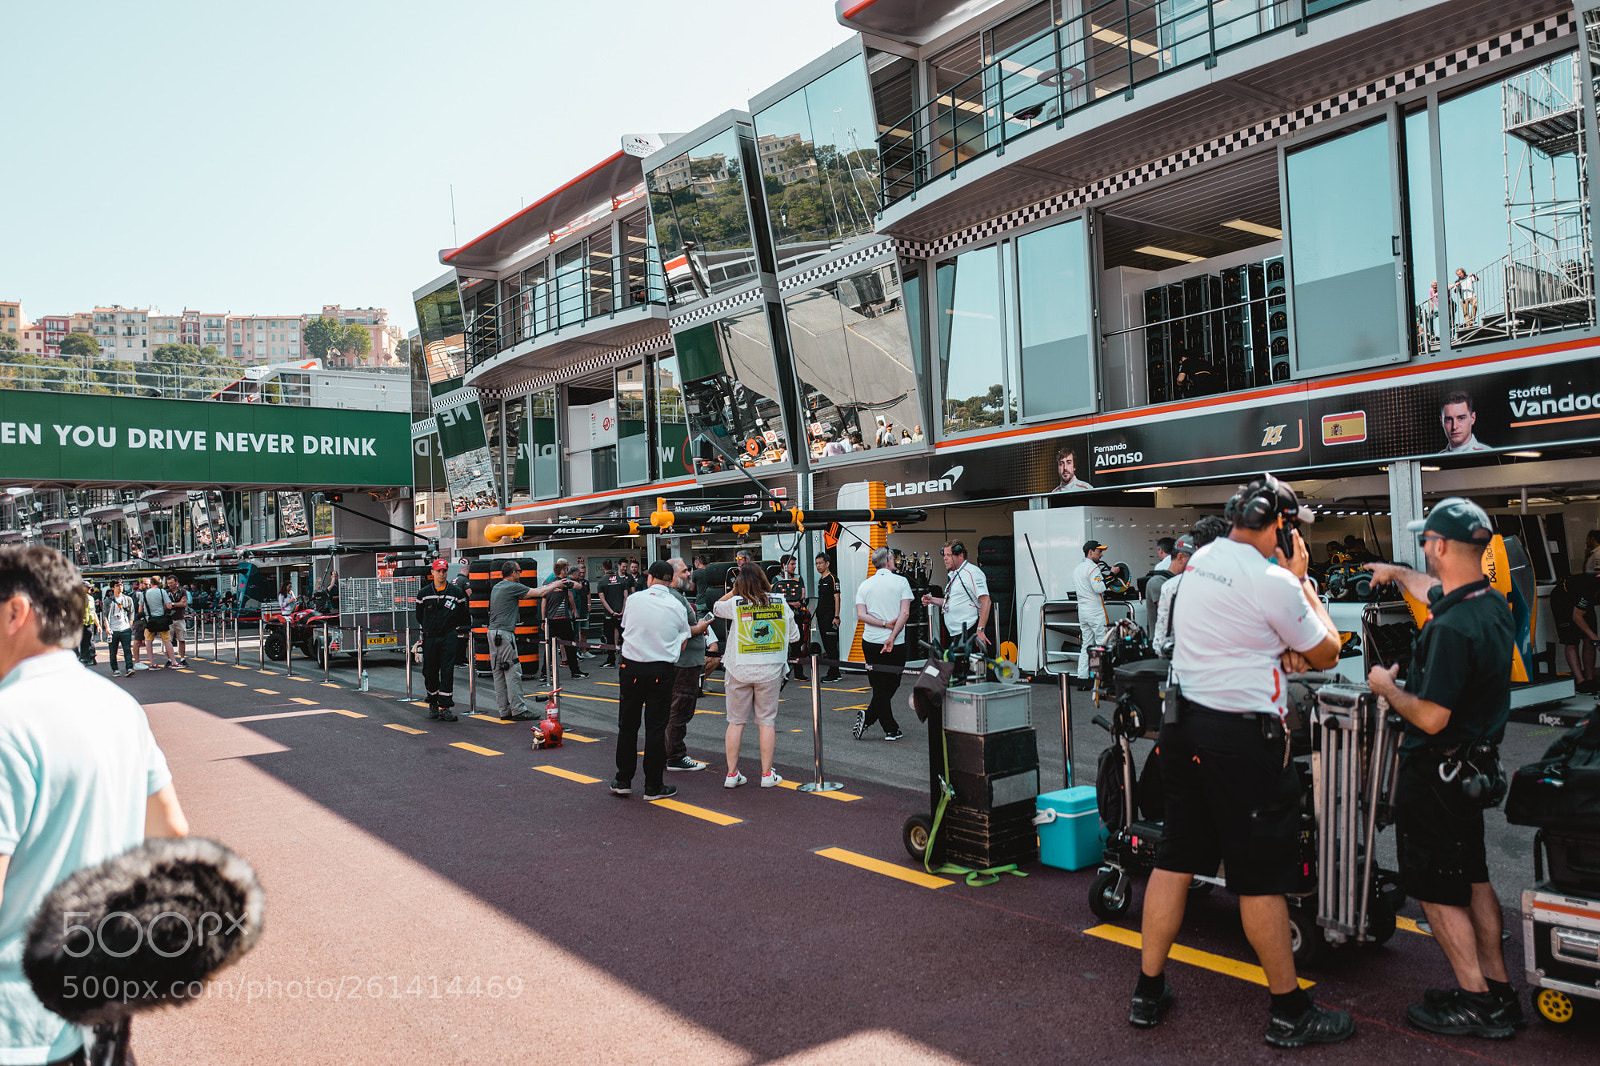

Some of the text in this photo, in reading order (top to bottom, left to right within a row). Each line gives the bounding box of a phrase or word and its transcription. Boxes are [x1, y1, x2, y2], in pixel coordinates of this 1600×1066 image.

[1508, 384, 1552, 400] Stoffel
[1, 422, 377, 456] EN YOU DRIVE NEVER DRINK
[1261, 424, 1287, 447] 14
[1094, 442, 1127, 453] Fernando
[1095, 450, 1143, 467] Alonso
[885, 474, 956, 497] cLaren
[707, 514, 761, 523] McLaren
[553, 525, 602, 534] McLaren
[1195, 567, 1227, 584] Formula
